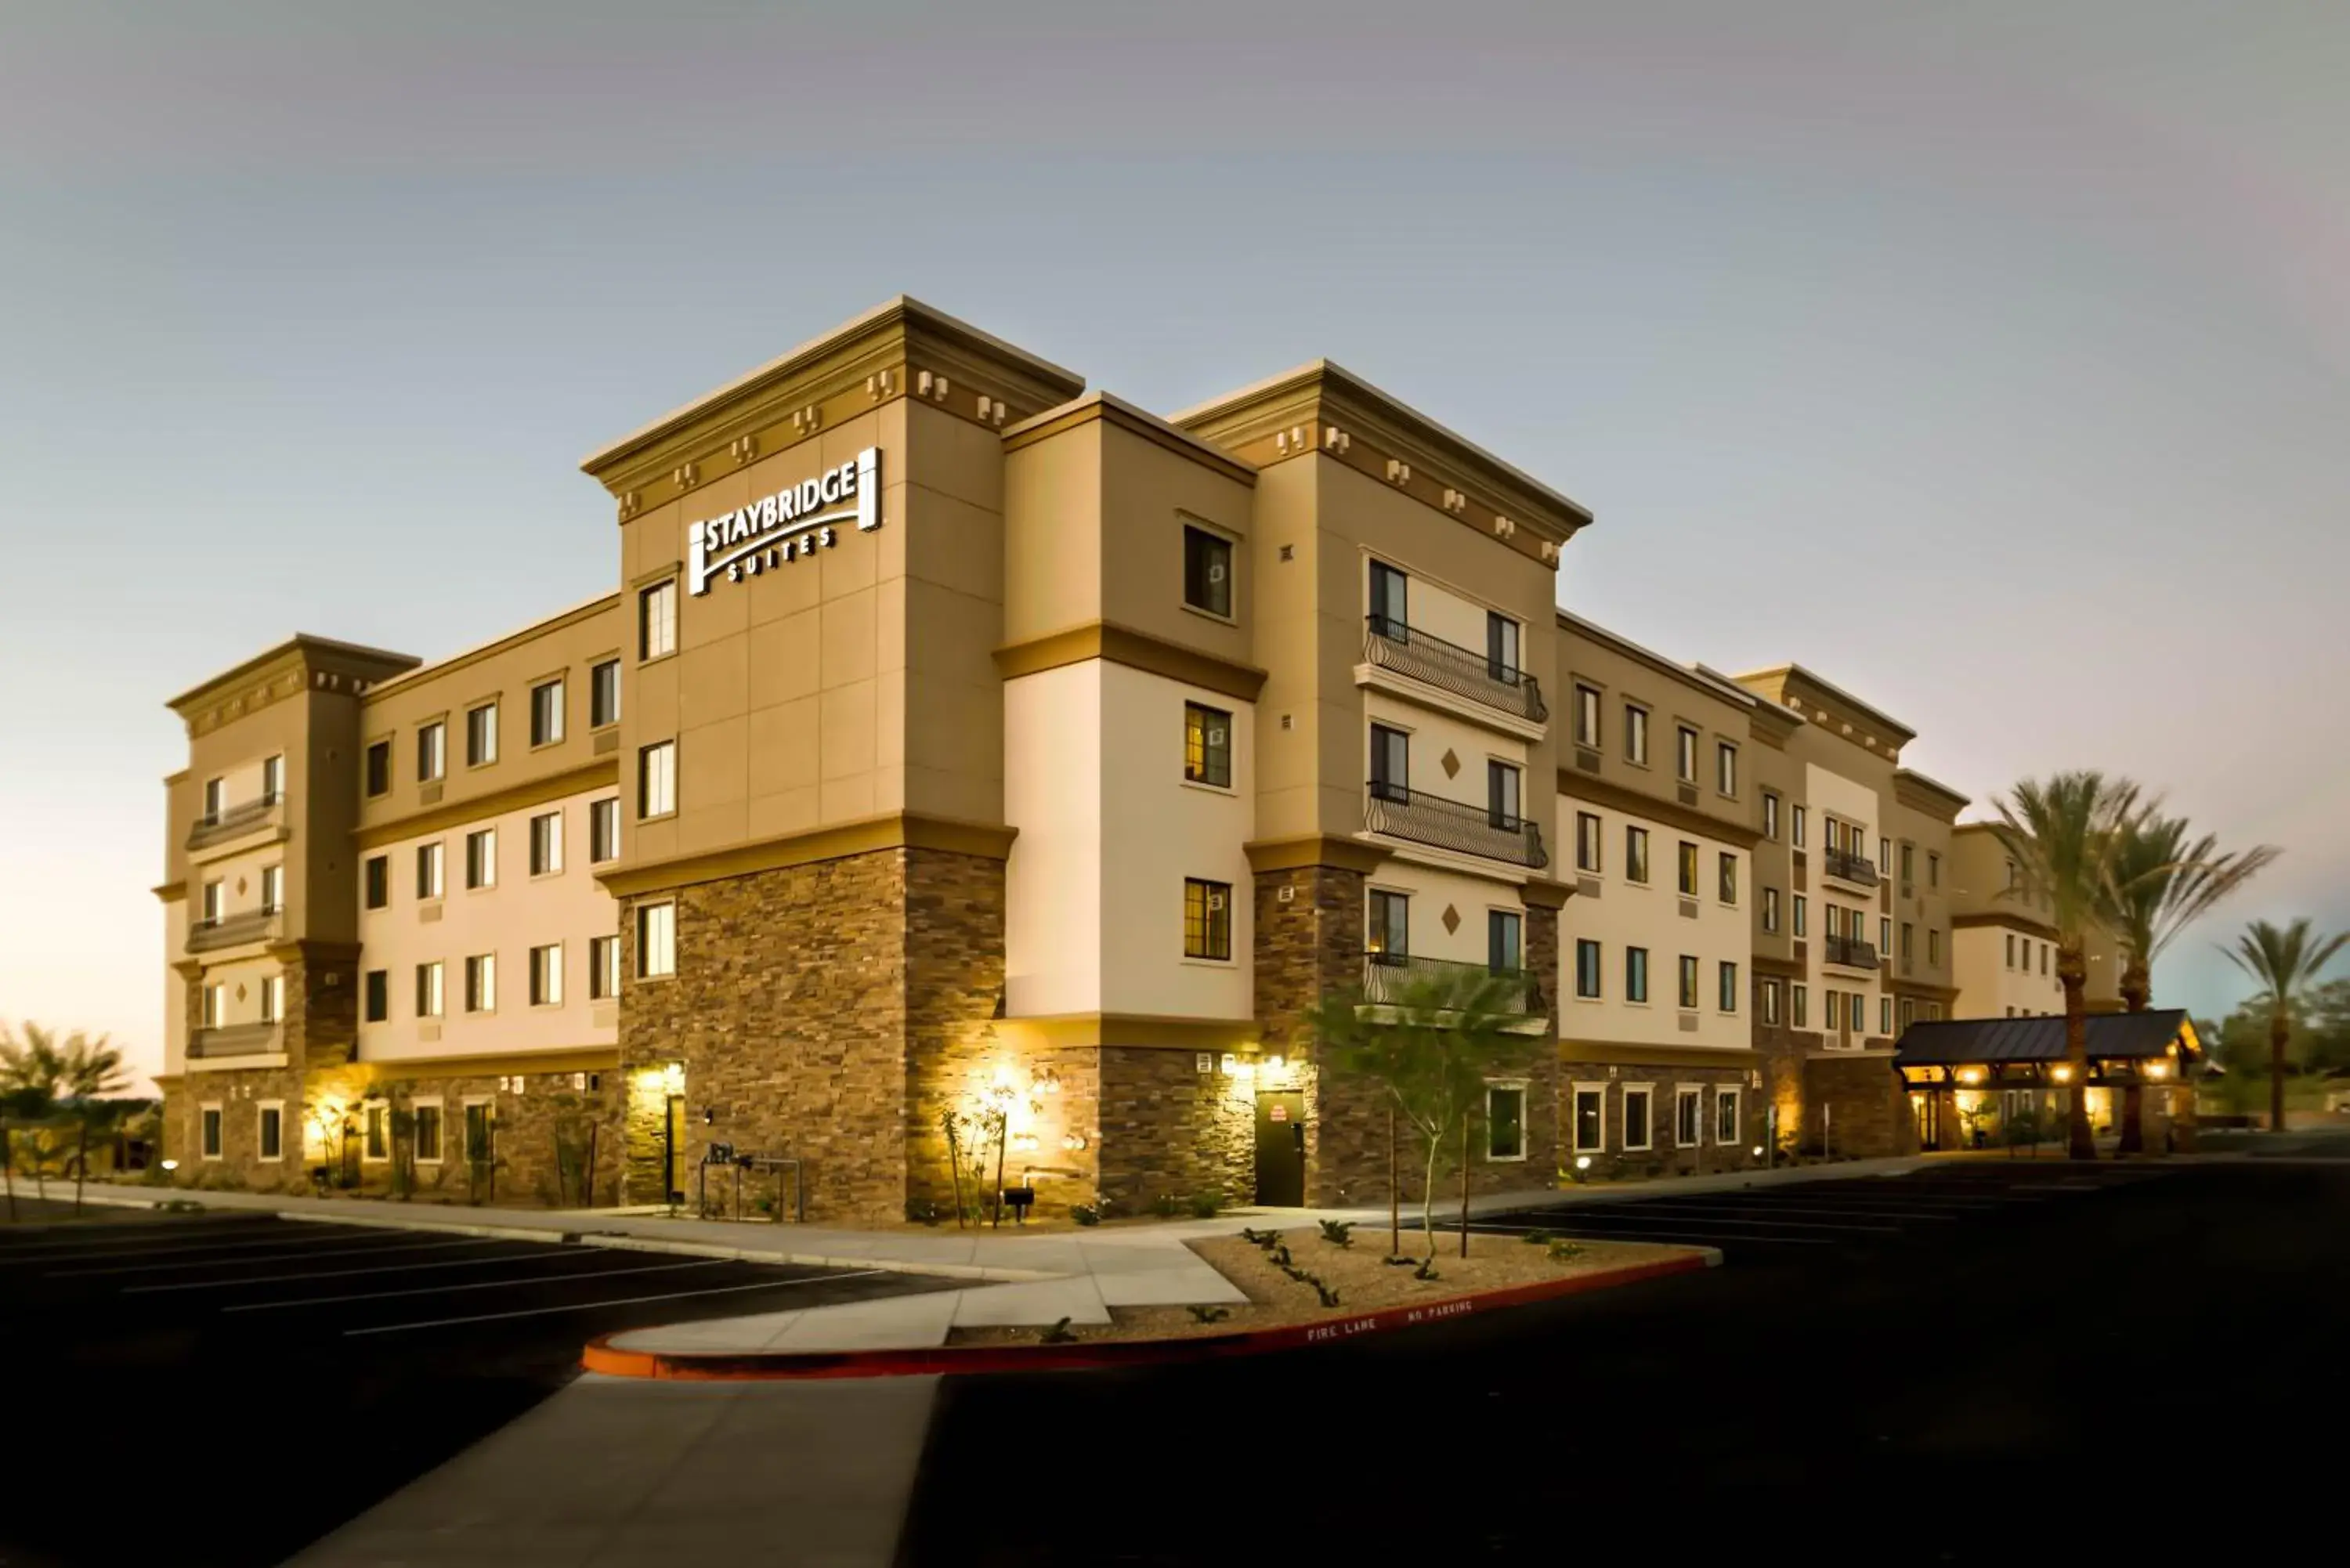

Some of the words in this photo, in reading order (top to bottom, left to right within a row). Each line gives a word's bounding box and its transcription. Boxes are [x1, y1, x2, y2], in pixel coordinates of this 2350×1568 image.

[706, 461, 856, 551] STAYBRIDGE
[728, 527, 830, 581] SUITES
[1307, 1326, 1337, 1342] FIRE
[1345, 1318, 1376, 1334] LANE
[1408, 1310, 1422, 1322] NO
[1429, 1300, 1472, 1317] PARKING
